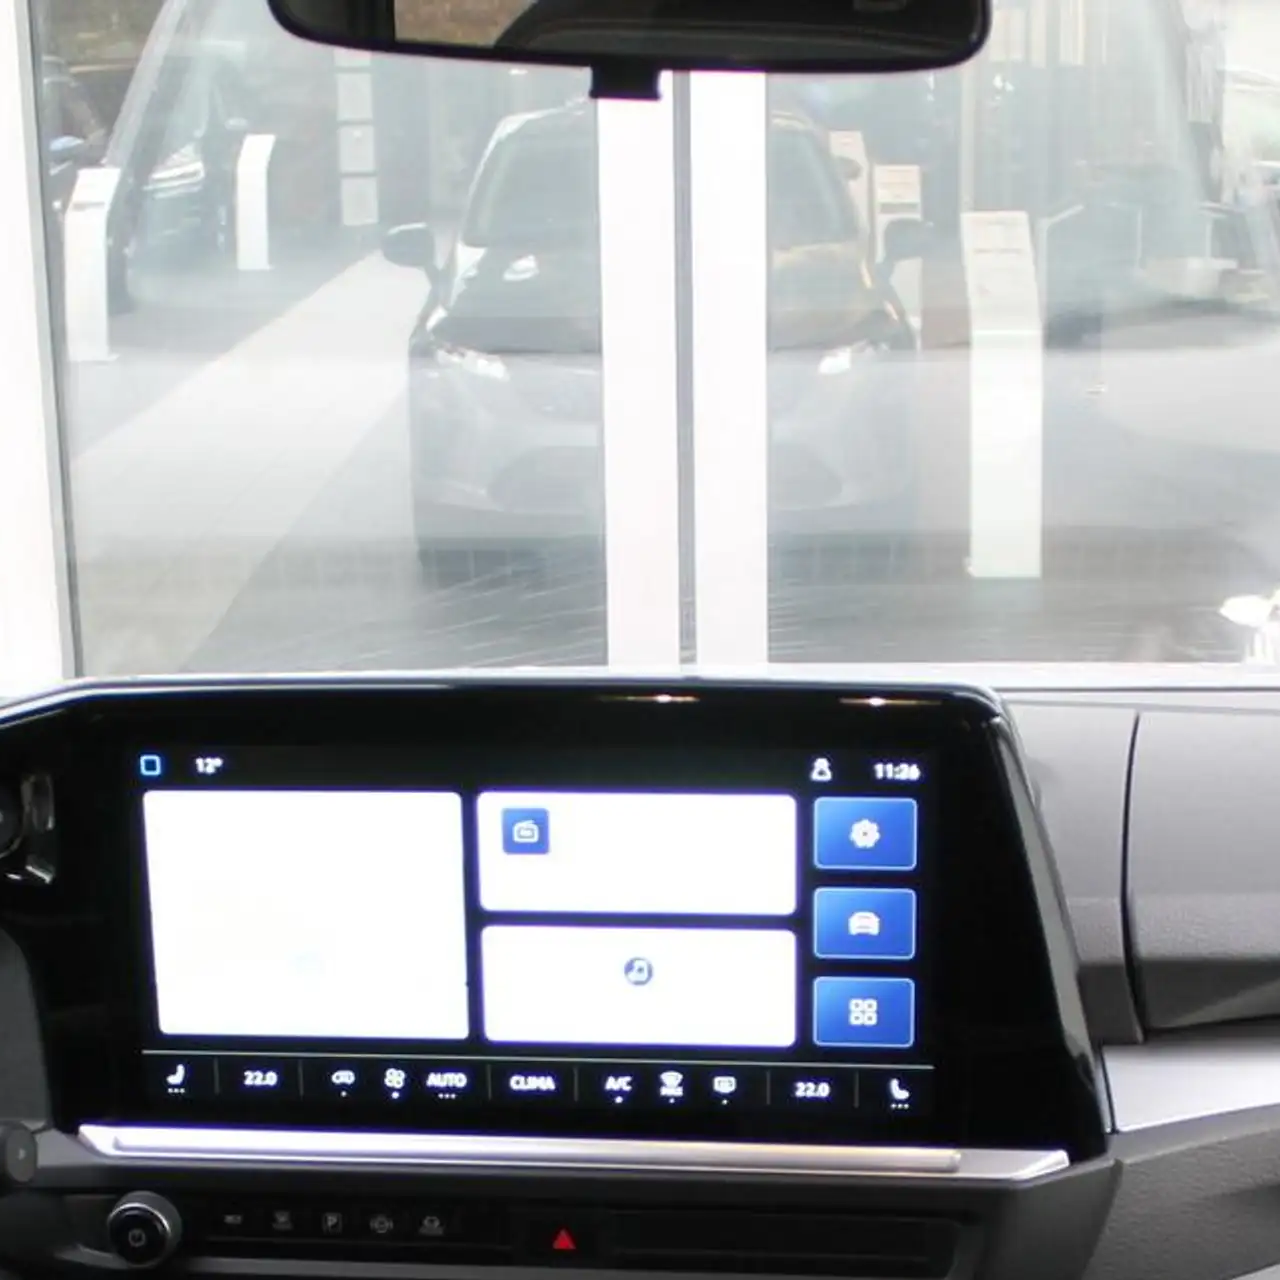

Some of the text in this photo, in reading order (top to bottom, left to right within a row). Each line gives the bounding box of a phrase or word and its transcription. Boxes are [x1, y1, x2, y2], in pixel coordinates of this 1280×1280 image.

[243, 1070, 279, 1087] 22.0
[426, 1072, 468, 1089] AUTO
[509, 1074, 556, 1092] CLIMA
[794, 1081, 831, 1098] 22.0
